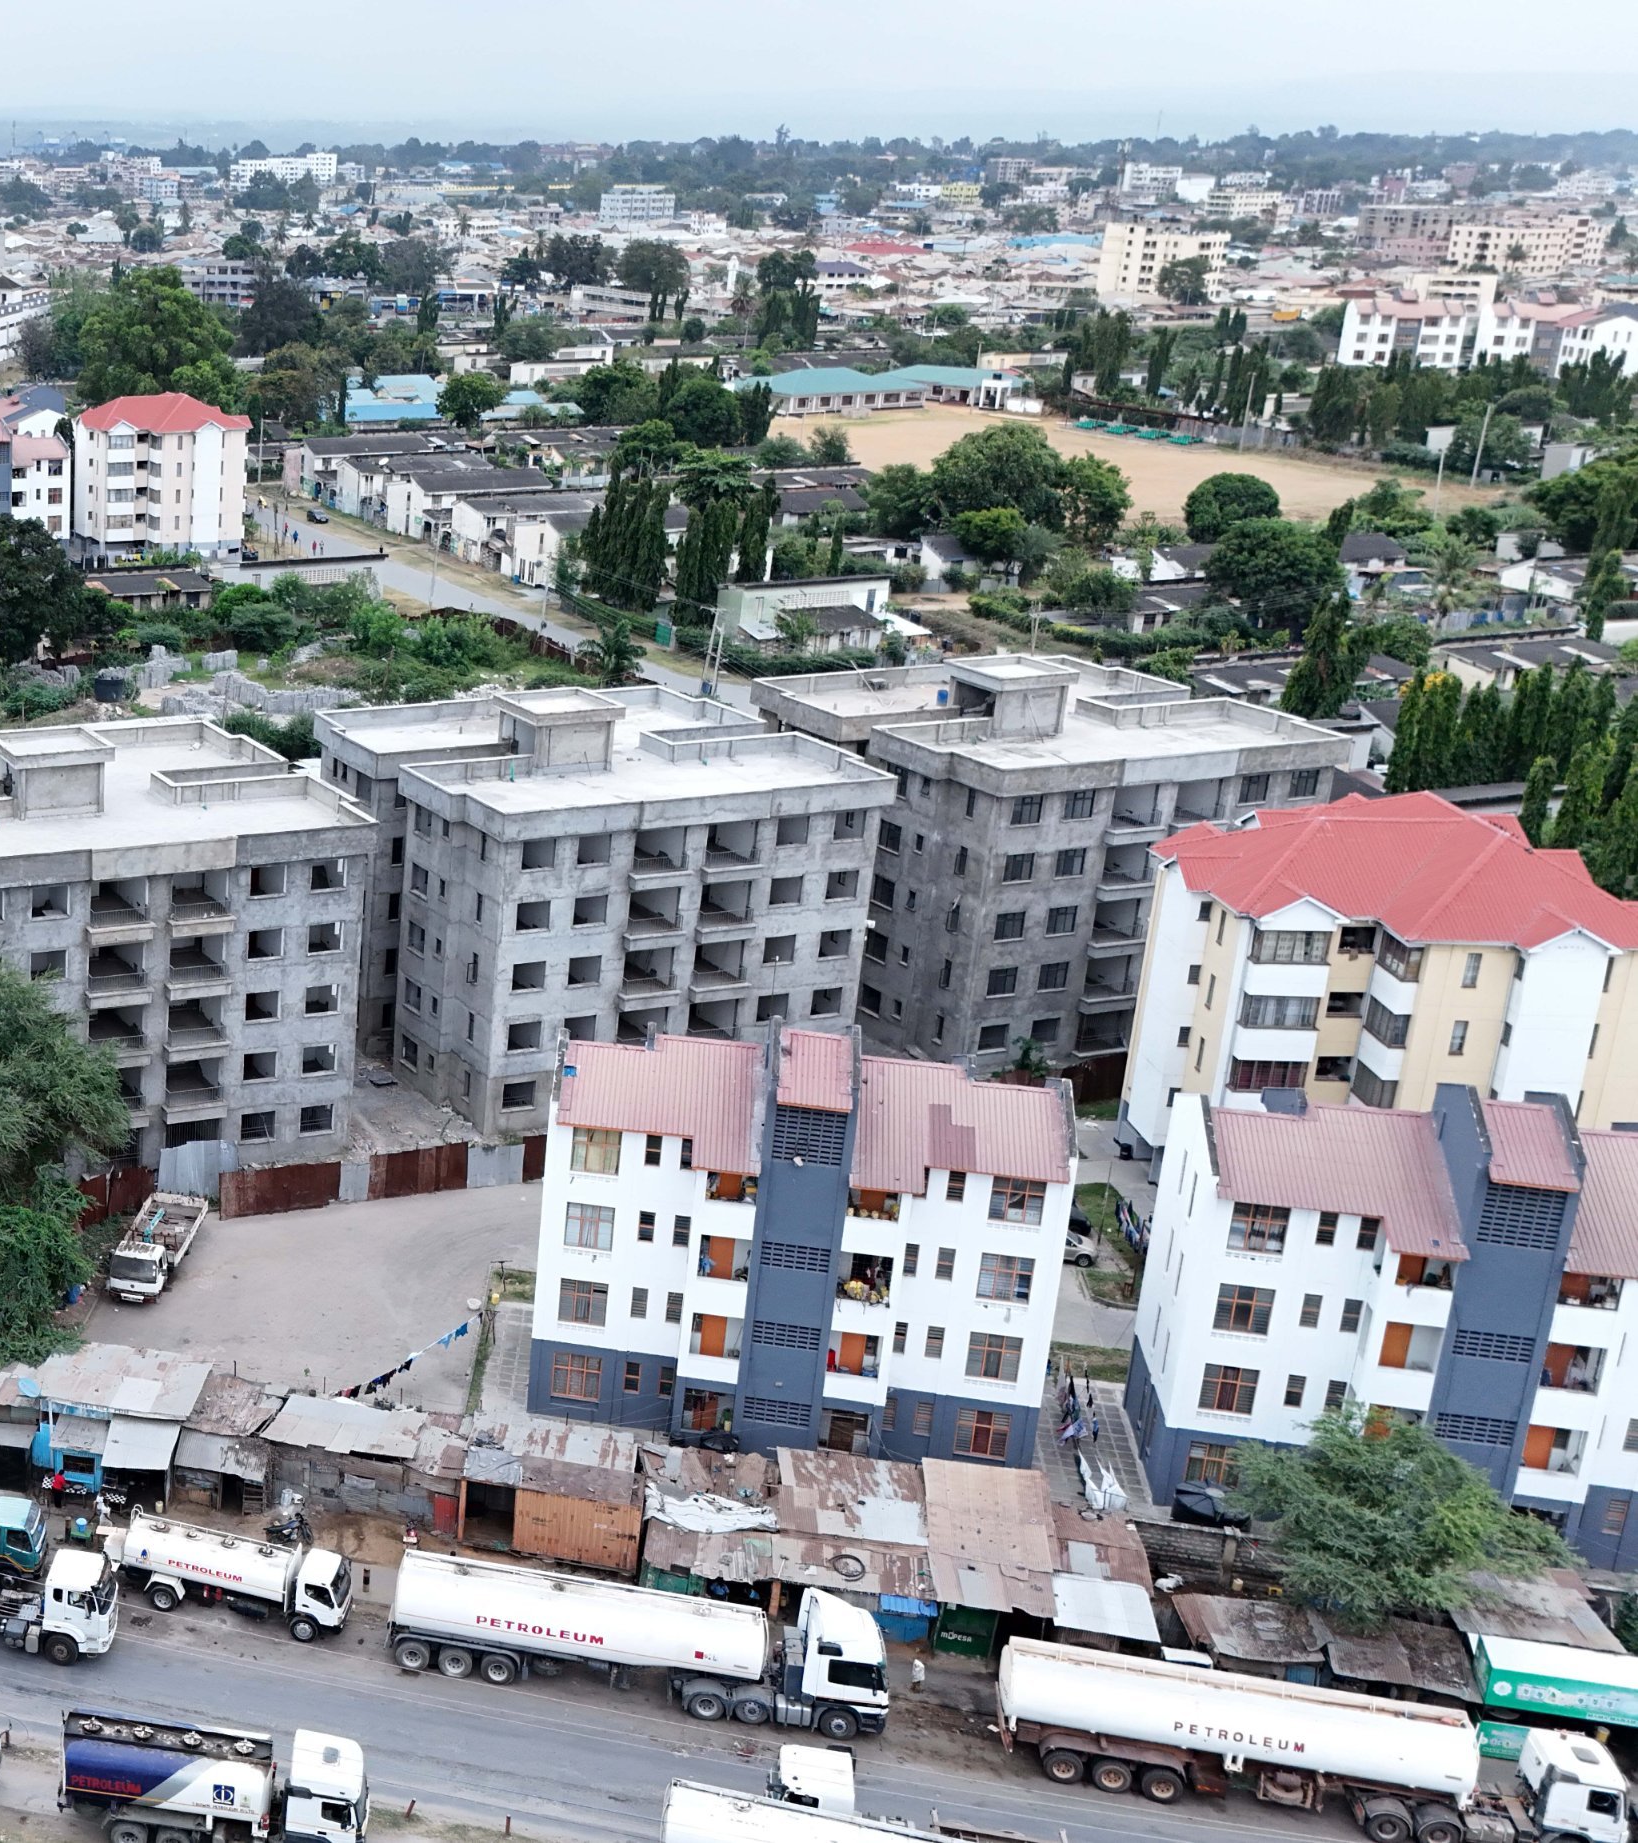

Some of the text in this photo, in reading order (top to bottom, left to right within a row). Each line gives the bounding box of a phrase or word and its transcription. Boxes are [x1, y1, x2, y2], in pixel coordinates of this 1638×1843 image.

[168, 1559, 243, 1582] PETROLEUM
[475, 1615, 604, 1645] PETROLEUM
[1173, 1721, 1305, 1753] PETROLEUM
[71, 1775, 141, 1794] PETROLEUM
